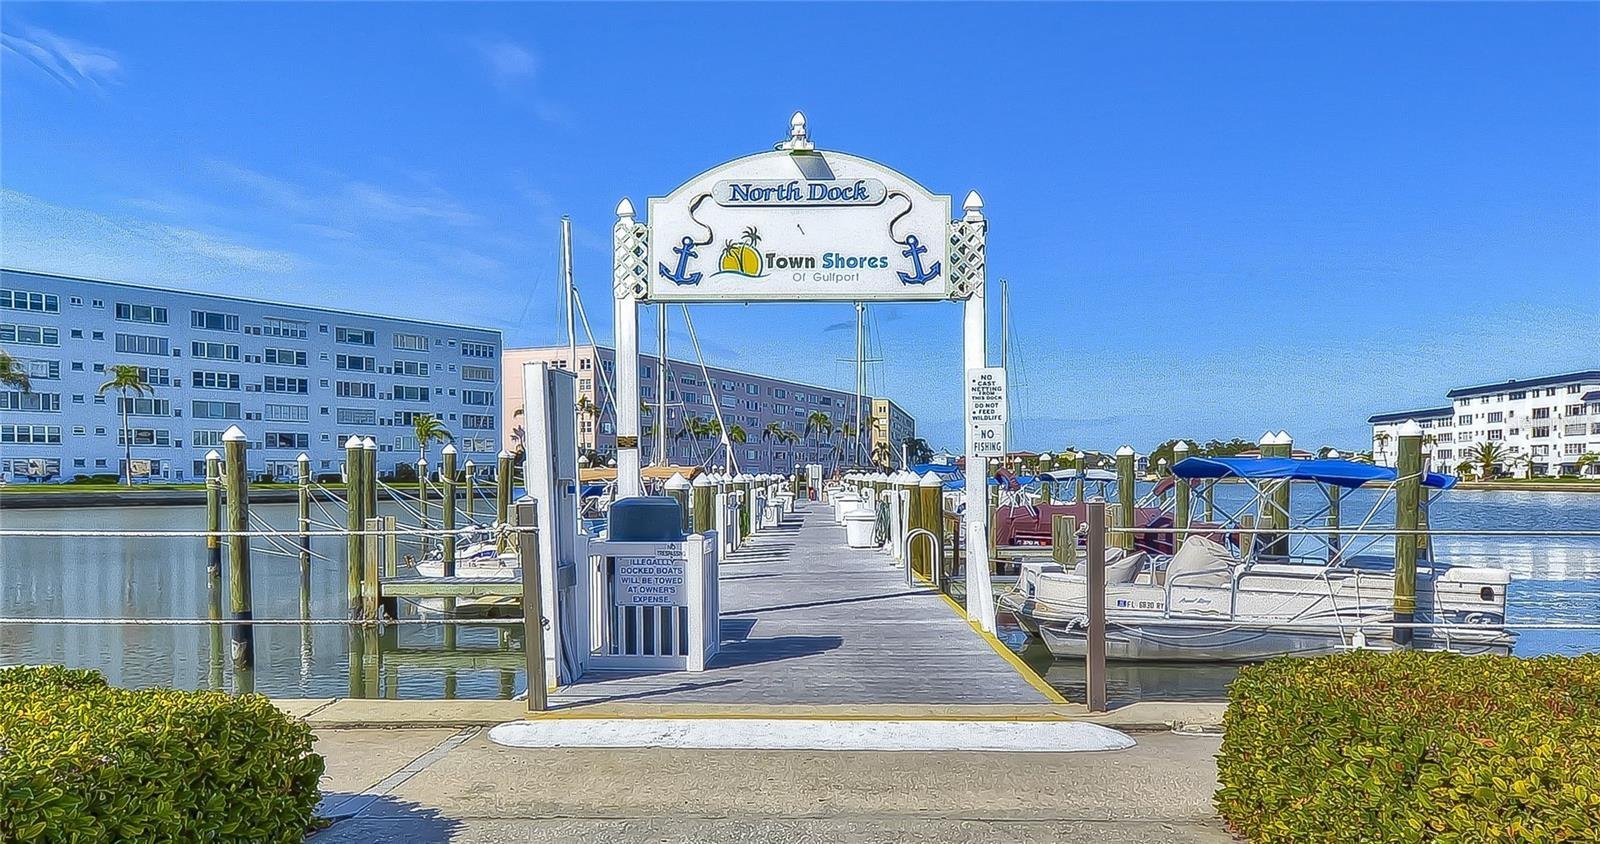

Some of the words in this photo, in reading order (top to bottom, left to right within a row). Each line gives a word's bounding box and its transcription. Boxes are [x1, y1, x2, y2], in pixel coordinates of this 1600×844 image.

[729, 181, 803, 201] North
[806, 180, 870, 201] Dock
[766, 253, 816, 269] Town
[822, 253, 888, 269] Shores
[793, 272, 806, 282] Of
[813, 272, 859, 283] Gulfport
[981, 429, 994, 439] NO
[974, 442, 1001, 451] FISHING
